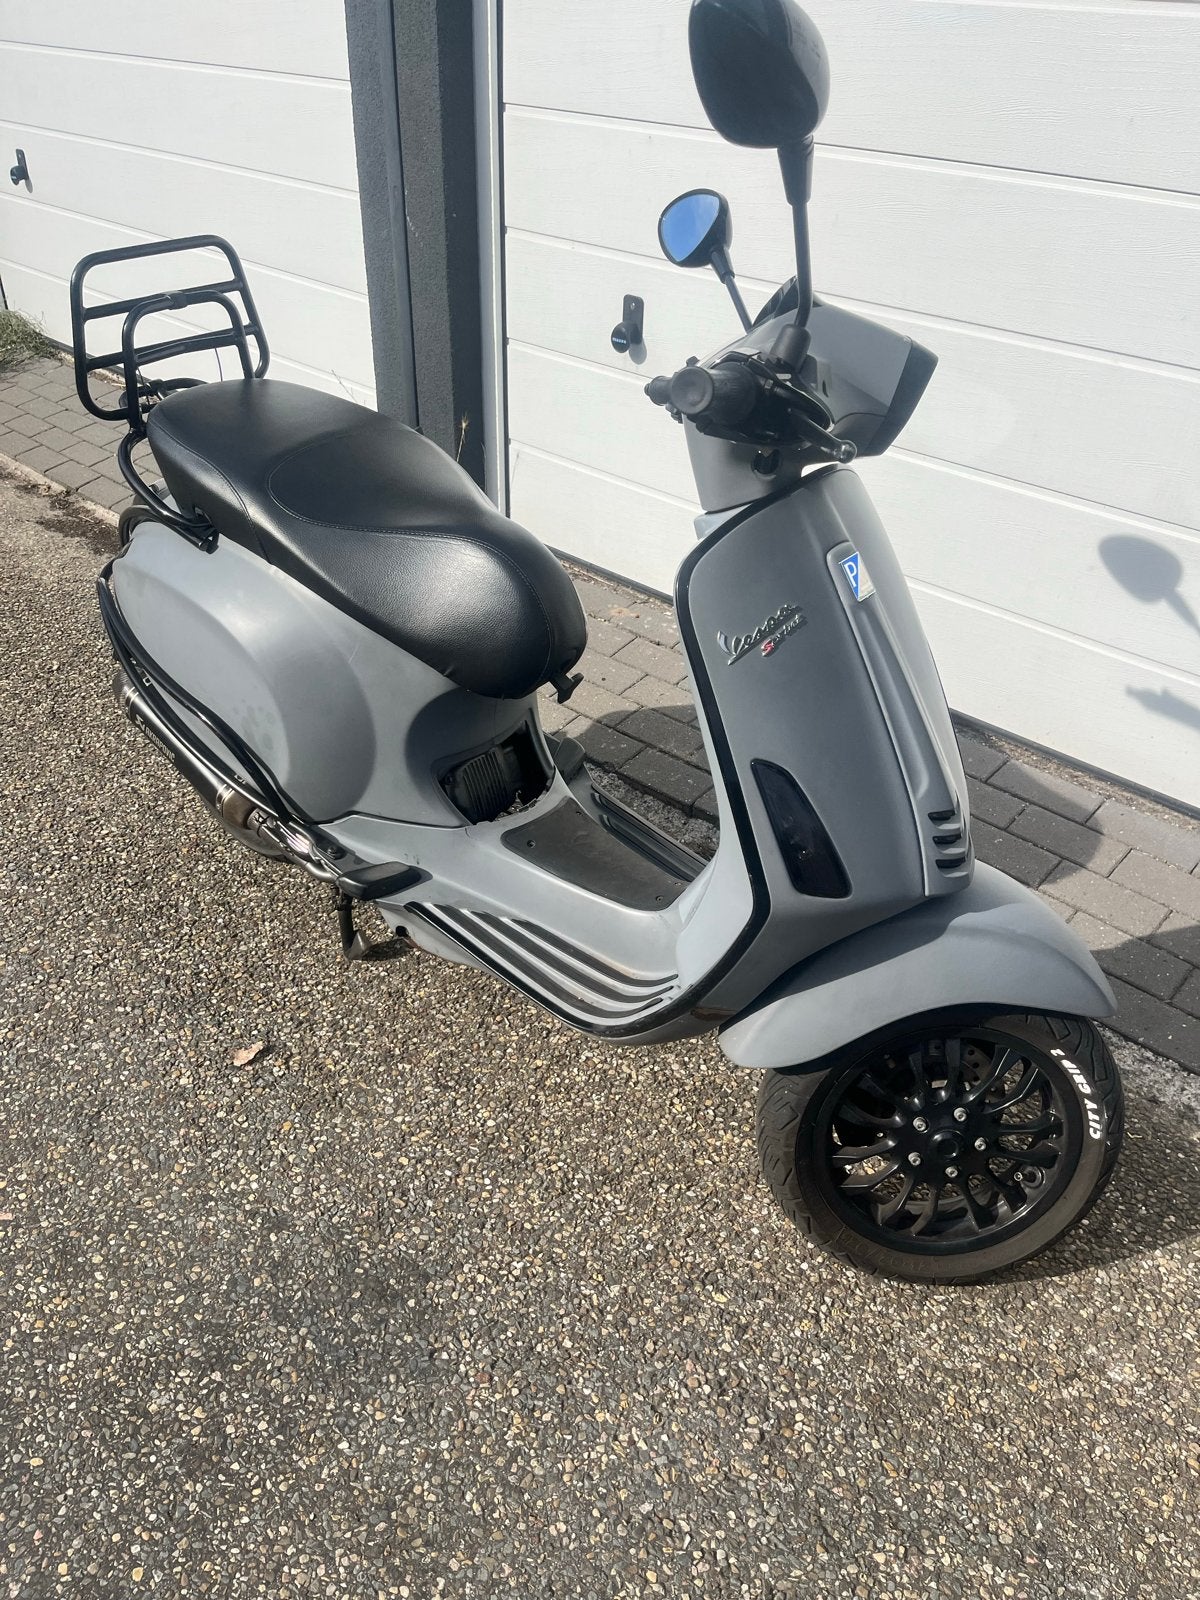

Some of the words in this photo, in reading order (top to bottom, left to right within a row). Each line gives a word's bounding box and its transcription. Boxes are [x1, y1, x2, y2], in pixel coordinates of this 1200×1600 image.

[844, 561, 857, 588] P
[717, 604, 801, 666] Vespa
[1050, 1048, 1065, 1057] 2
[1061, 1059, 1091, 1094] GRIP
[1084, 1098, 1101, 1139] CITY
